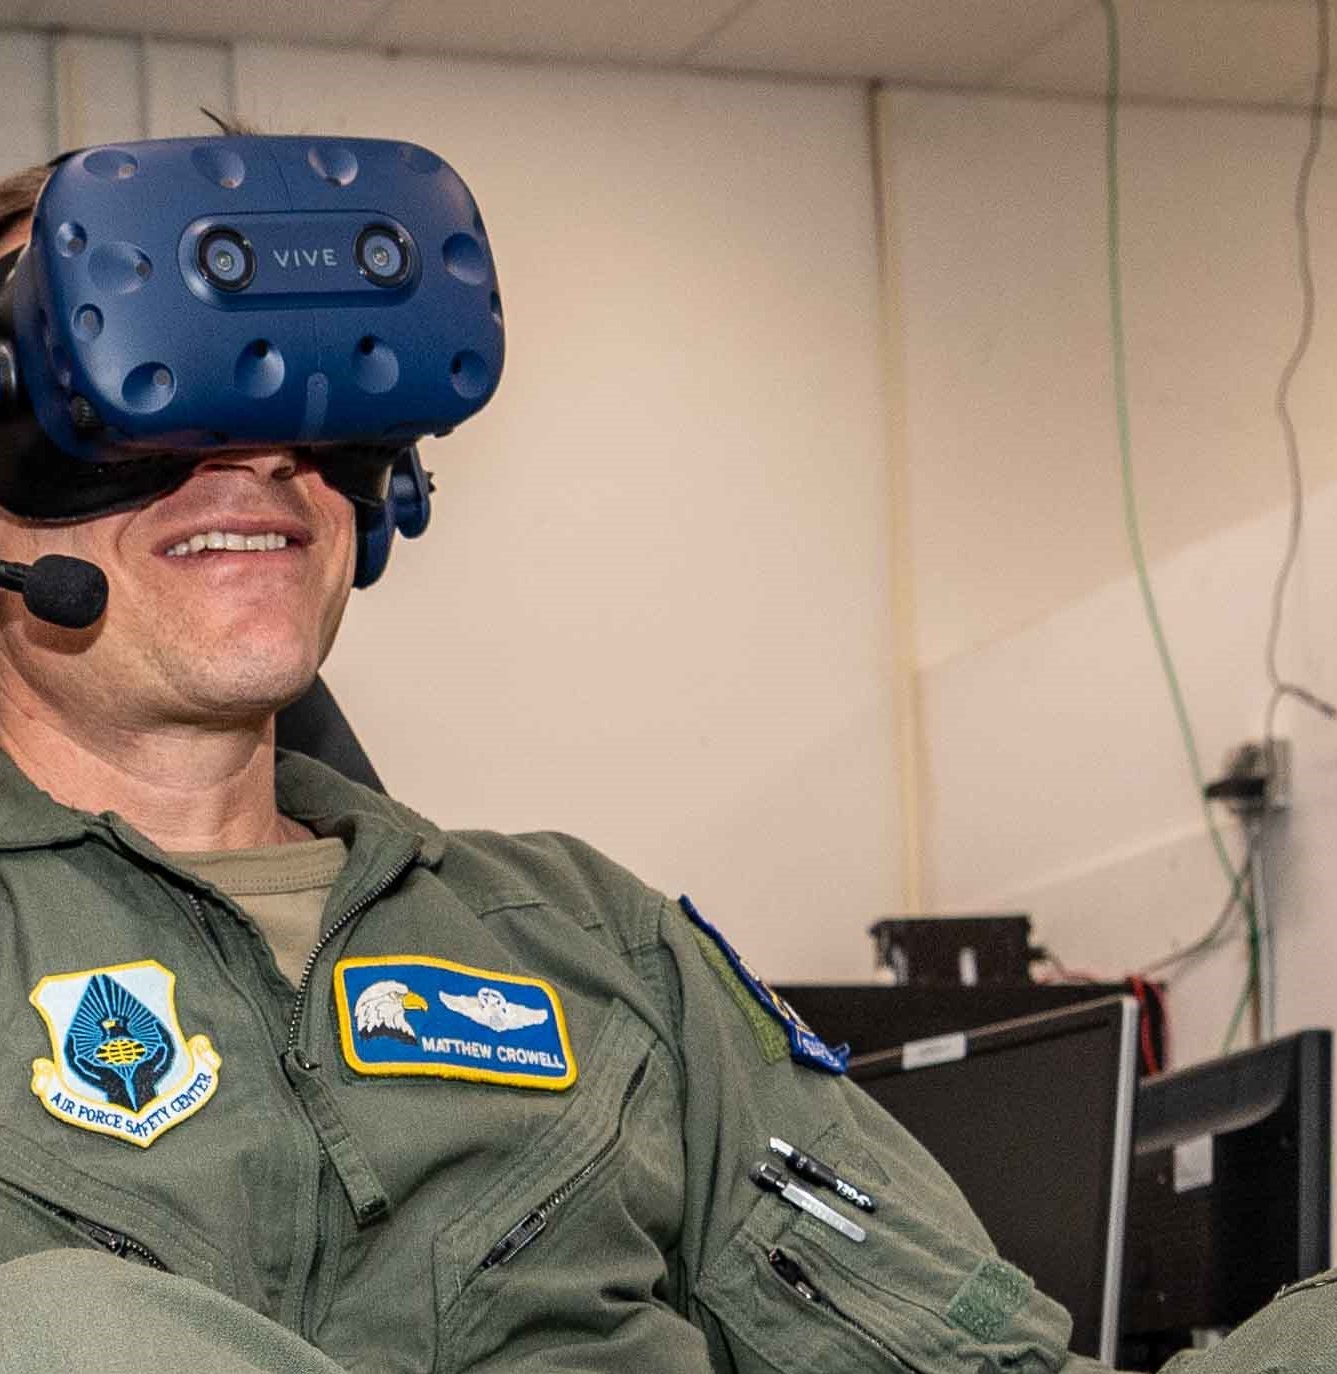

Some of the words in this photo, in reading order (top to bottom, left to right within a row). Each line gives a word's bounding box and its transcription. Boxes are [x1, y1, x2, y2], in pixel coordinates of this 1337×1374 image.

[272, 248, 338, 268] VIVE
[421, 1036, 492, 1060] MATTHEW
[496, 1045, 566, 1069] CROWELL
[50, 1092, 75, 1115] AIR
[78, 1106, 123, 1129] FORCE
[125, 1106, 172, 1137] SAFETY
[170, 1072, 213, 1113] CENTER
